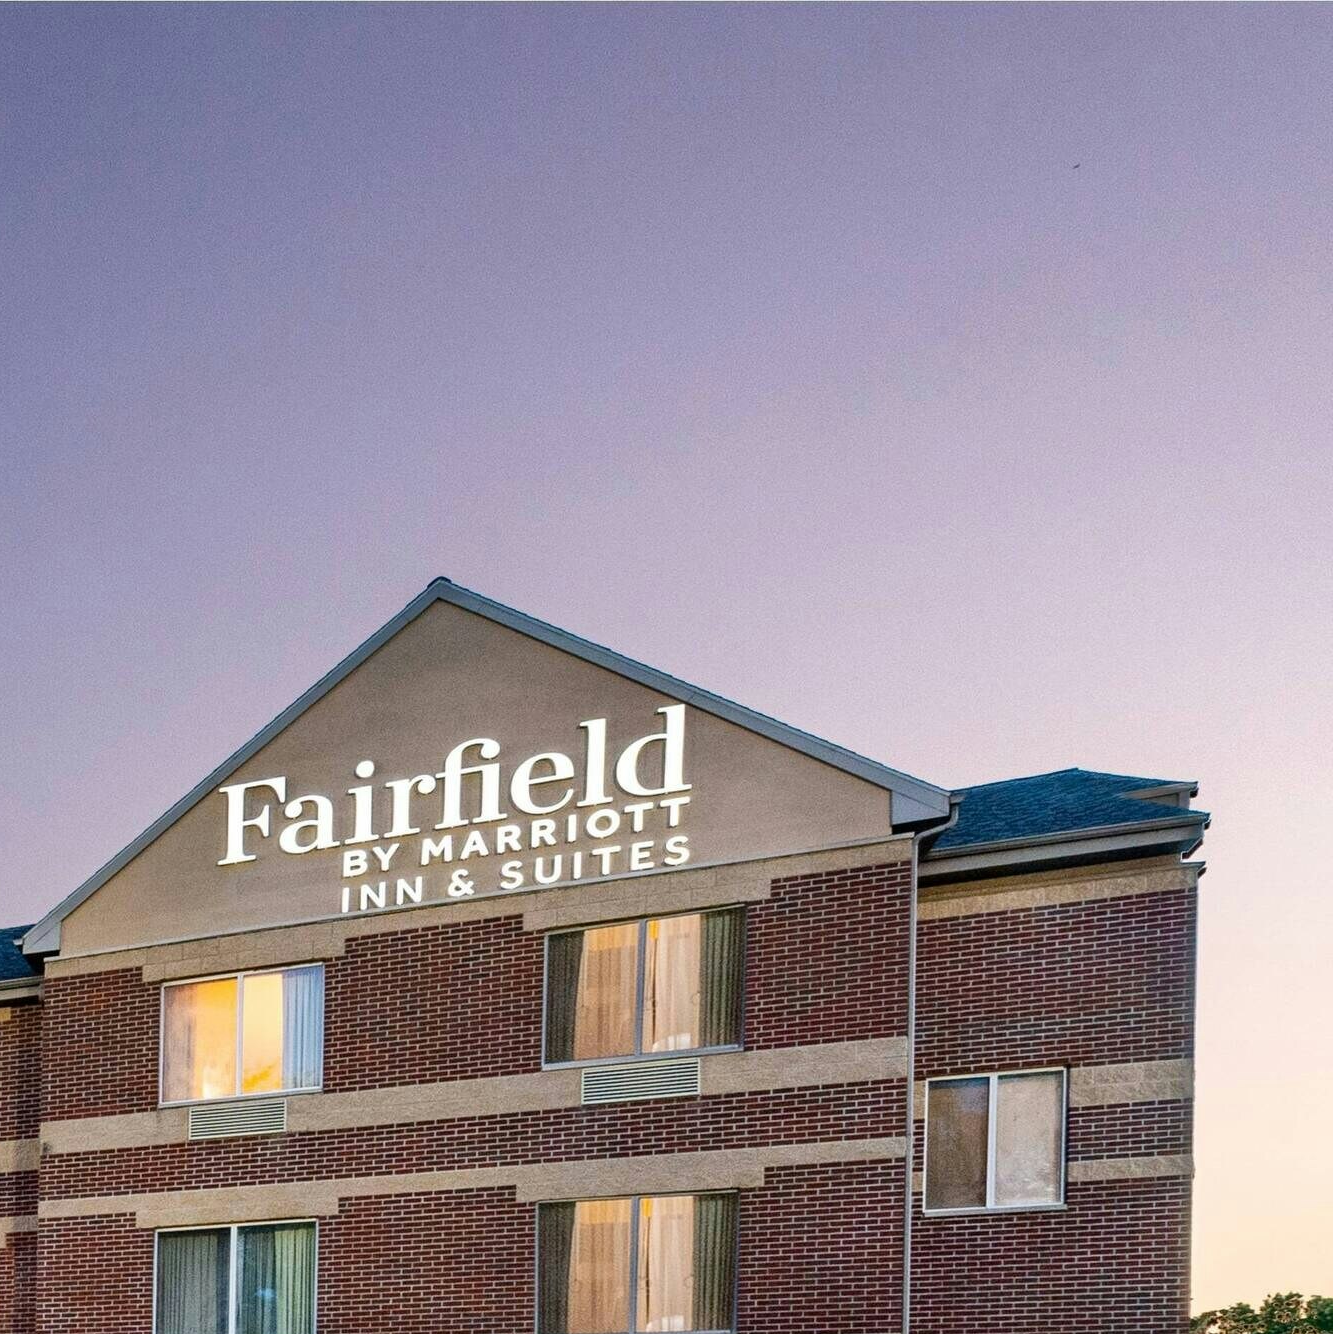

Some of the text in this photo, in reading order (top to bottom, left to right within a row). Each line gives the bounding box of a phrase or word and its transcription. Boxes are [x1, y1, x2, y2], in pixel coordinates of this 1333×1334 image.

[217, 703, 693, 865] Fairfield
[341, 835, 691, 914] INN & SUITES
[342, 795, 691, 877] BY MARRIOTT
